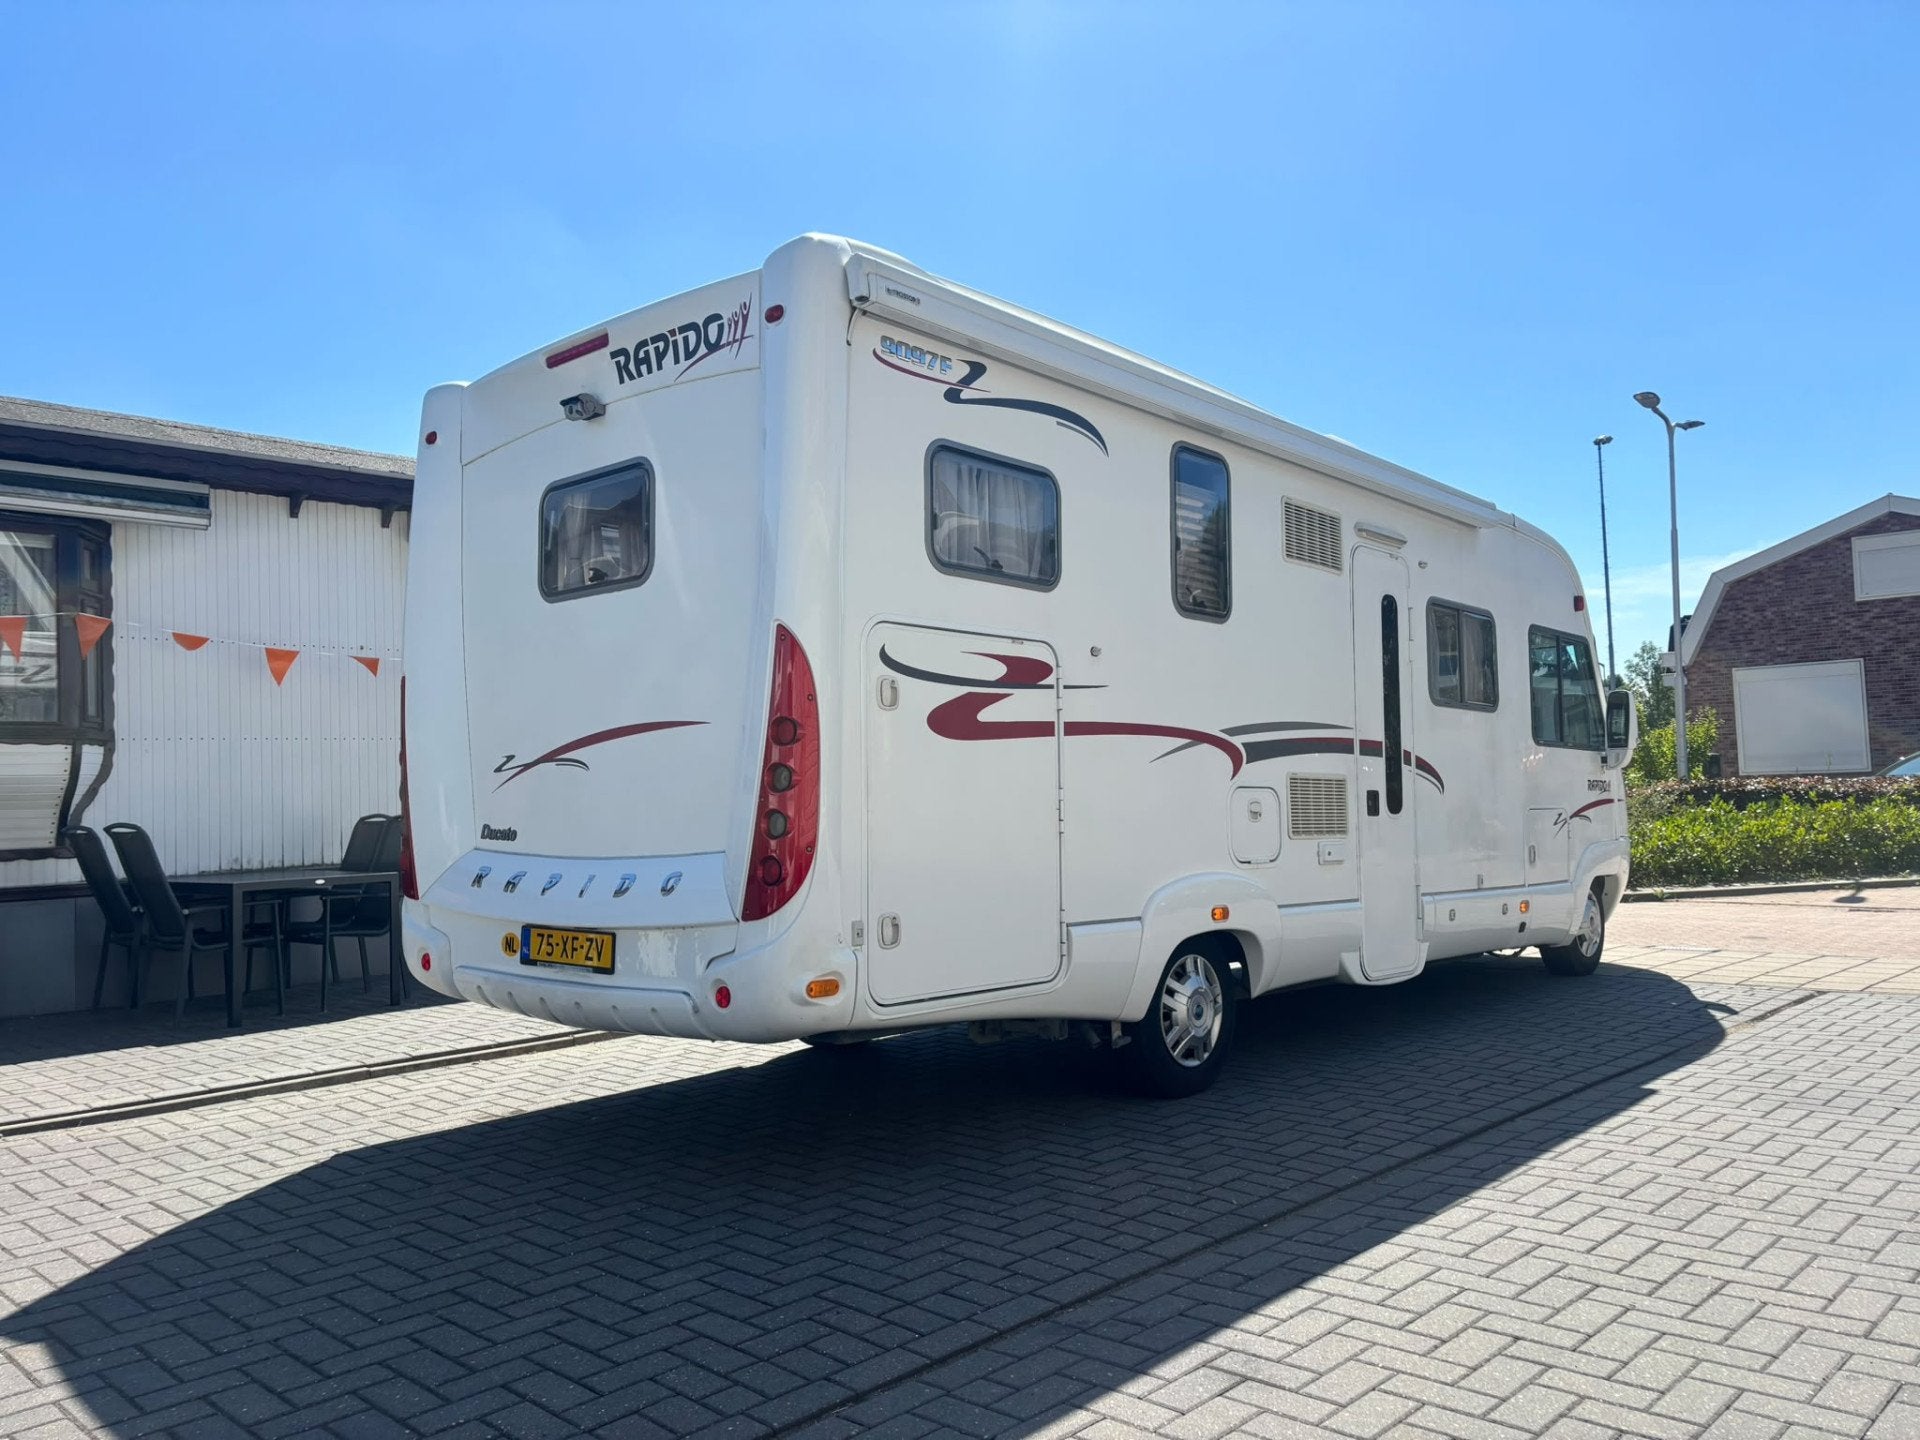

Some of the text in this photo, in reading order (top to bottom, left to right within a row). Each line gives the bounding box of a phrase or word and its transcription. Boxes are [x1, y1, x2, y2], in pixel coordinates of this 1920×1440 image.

[880, 335, 953, 375] 9097F
[480, 823, 517, 841] Ducato
[471, 866, 683, 898] RAPIDO
[505, 936, 517, 954] NL
[536, 933, 605, 962] 75-XF-ZV
